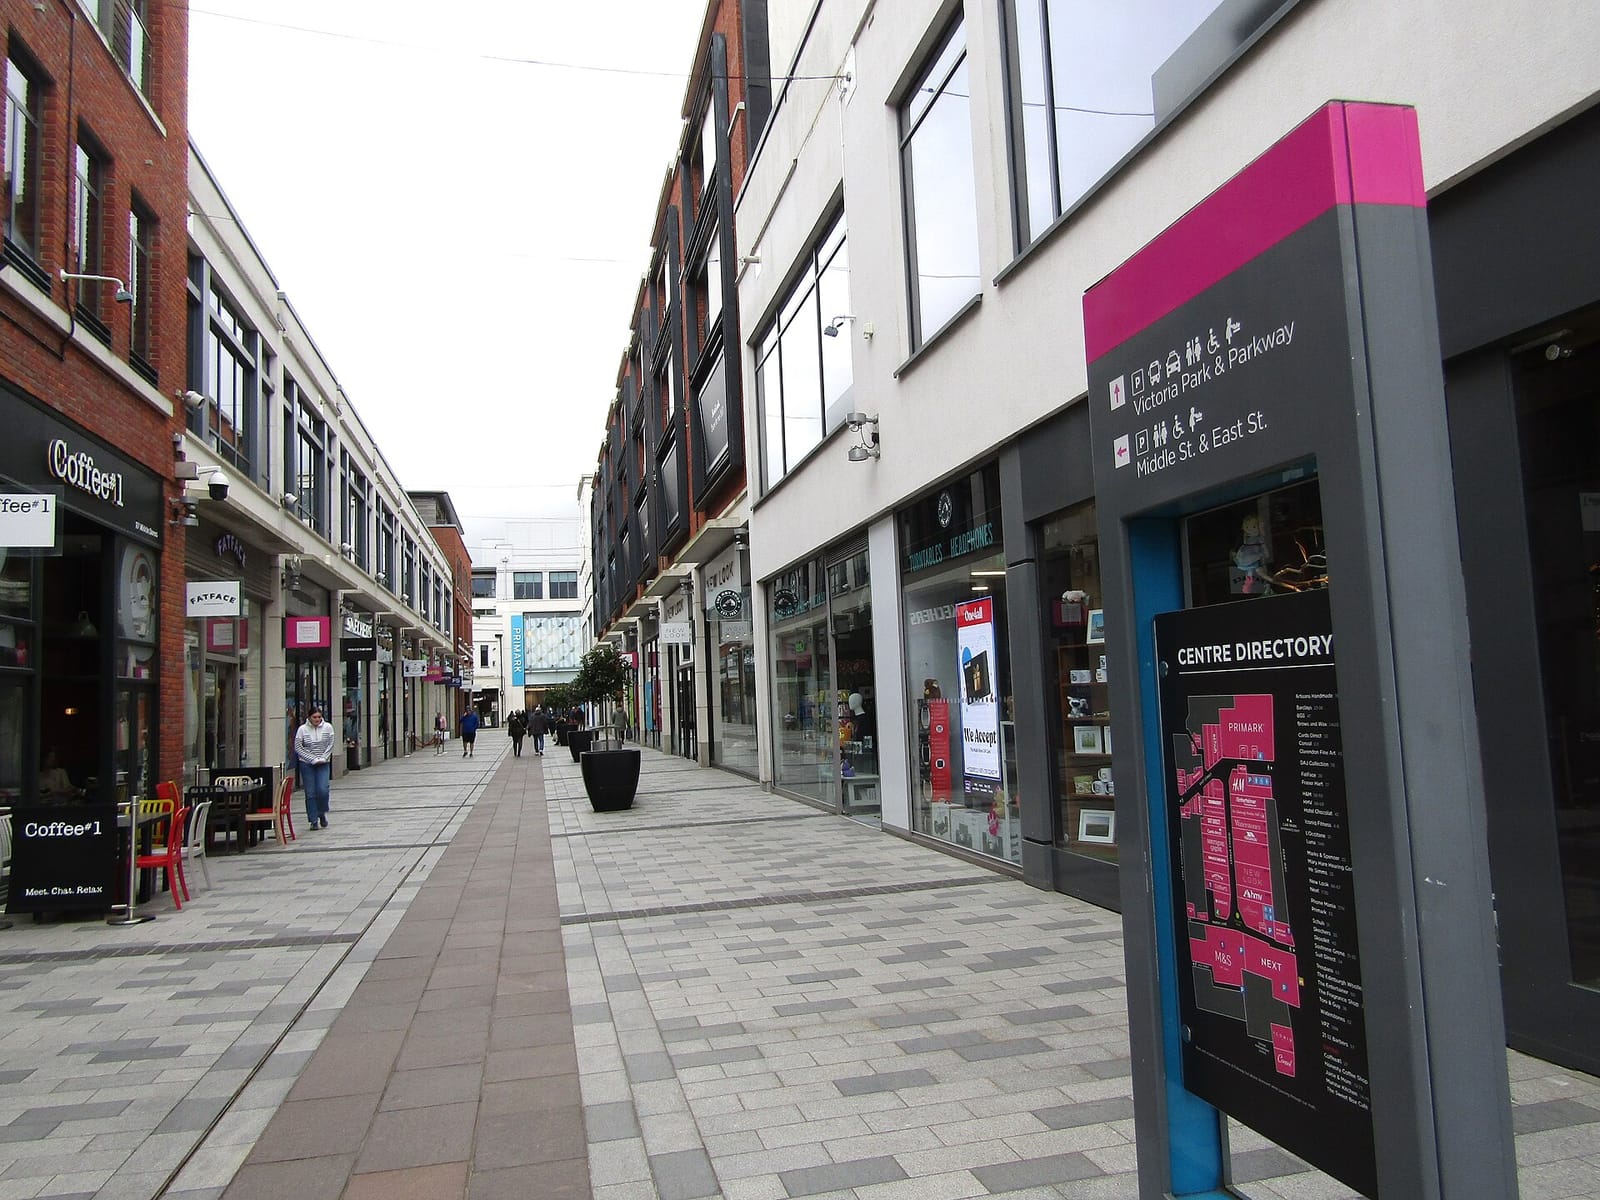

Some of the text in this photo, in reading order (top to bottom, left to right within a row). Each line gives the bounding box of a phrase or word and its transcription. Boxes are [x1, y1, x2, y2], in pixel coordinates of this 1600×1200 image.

[1133, 321, 1295, 416] Victoria Park & Parkway
[1137, 411, 1268, 478] Middle St. & East St.
[49, 439, 124, 507] Coffee#1
[0, 498, 50, 513] fee#1
[950, 522, 994, 558] HEADPHONES
[718, 561, 734, 586] LOOK
[190, 592, 237, 605] FATFACE
[513, 627, 522, 673] PRIMARK
[1178, 634, 1333, 665] CENTRE DIRECTORY
[964, 728, 997, 748] We Accept
[1228, 723, 1264, 733] PRIMARK
[25, 821, 102, 837] Coffee#1
[25, 885, 103, 896] Meet. Chat. Relax
[1214, 950, 1232, 967] M&S
[1261, 957, 1282, 972] NEXT
